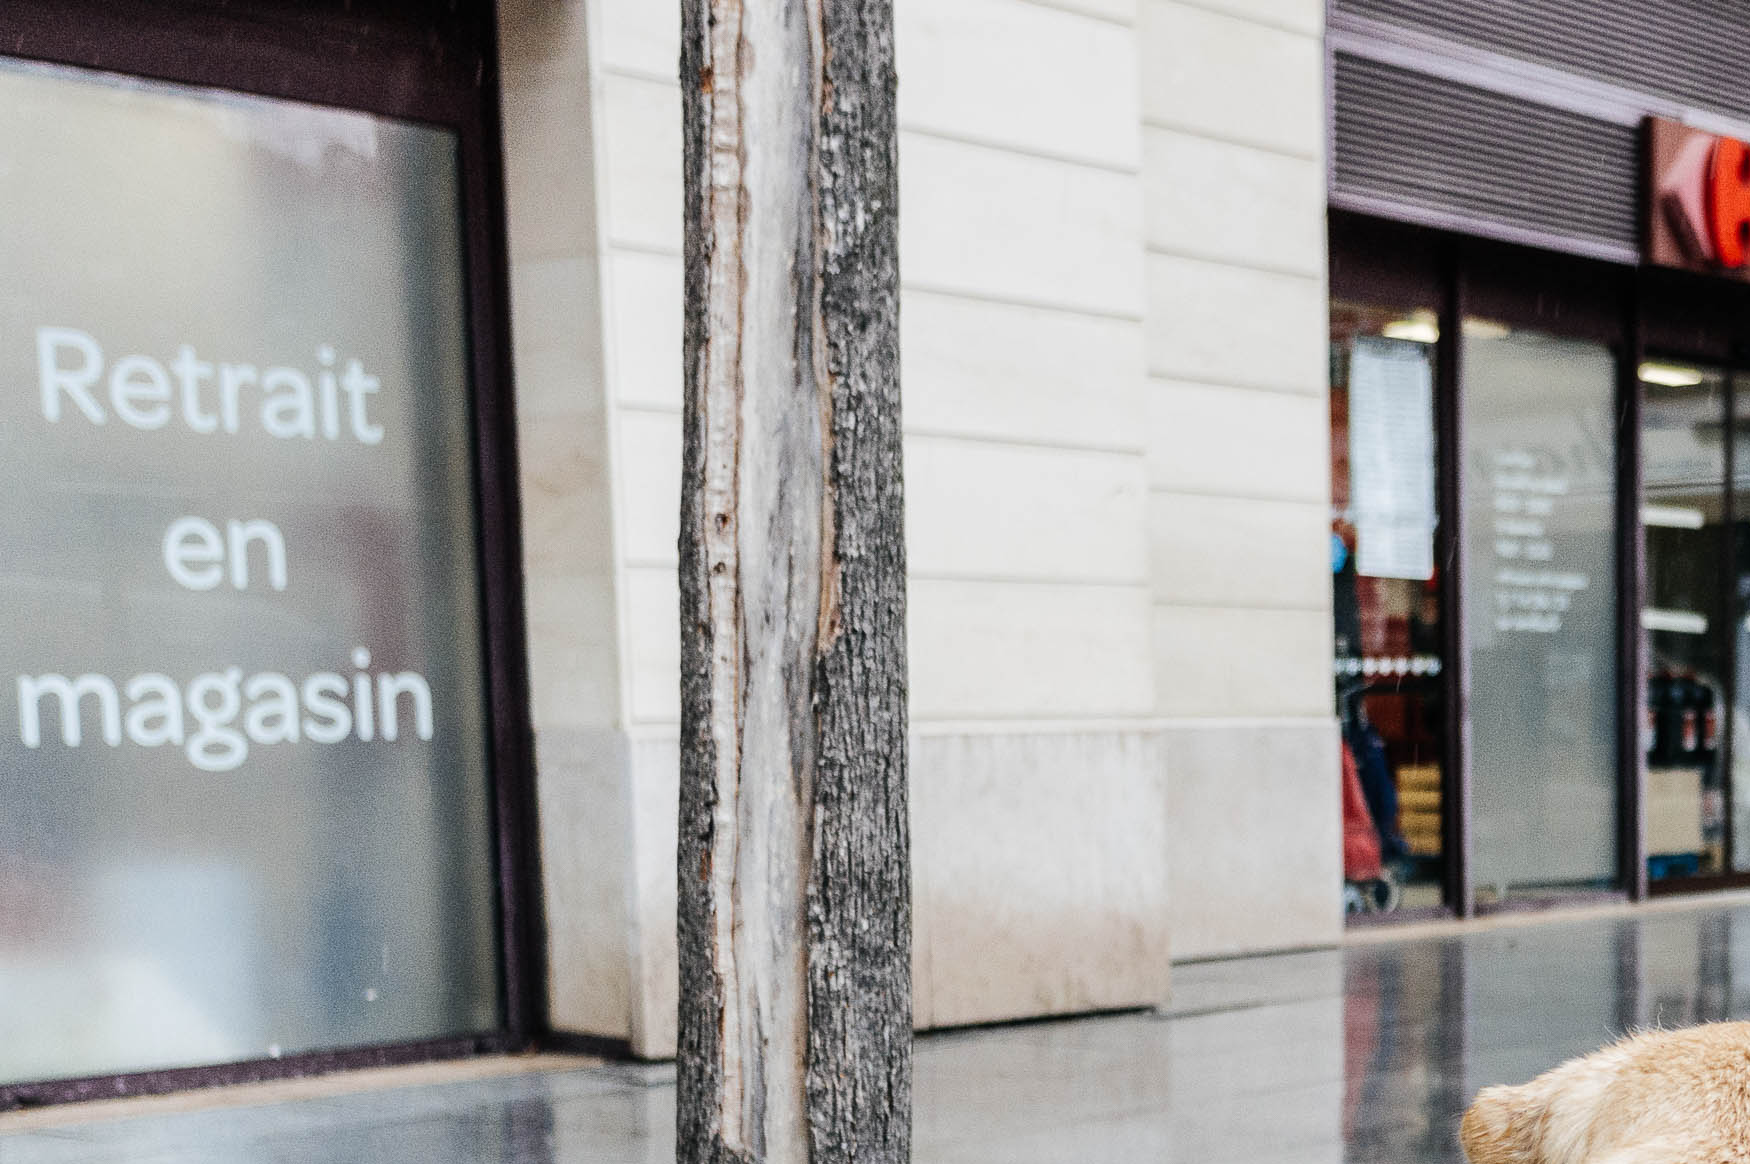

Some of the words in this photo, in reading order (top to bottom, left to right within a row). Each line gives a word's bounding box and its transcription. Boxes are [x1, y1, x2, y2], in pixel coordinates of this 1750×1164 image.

[35, 326, 385, 446] Retrait
[162, 515, 288, 592] en
[16, 647, 434, 772] magasin
